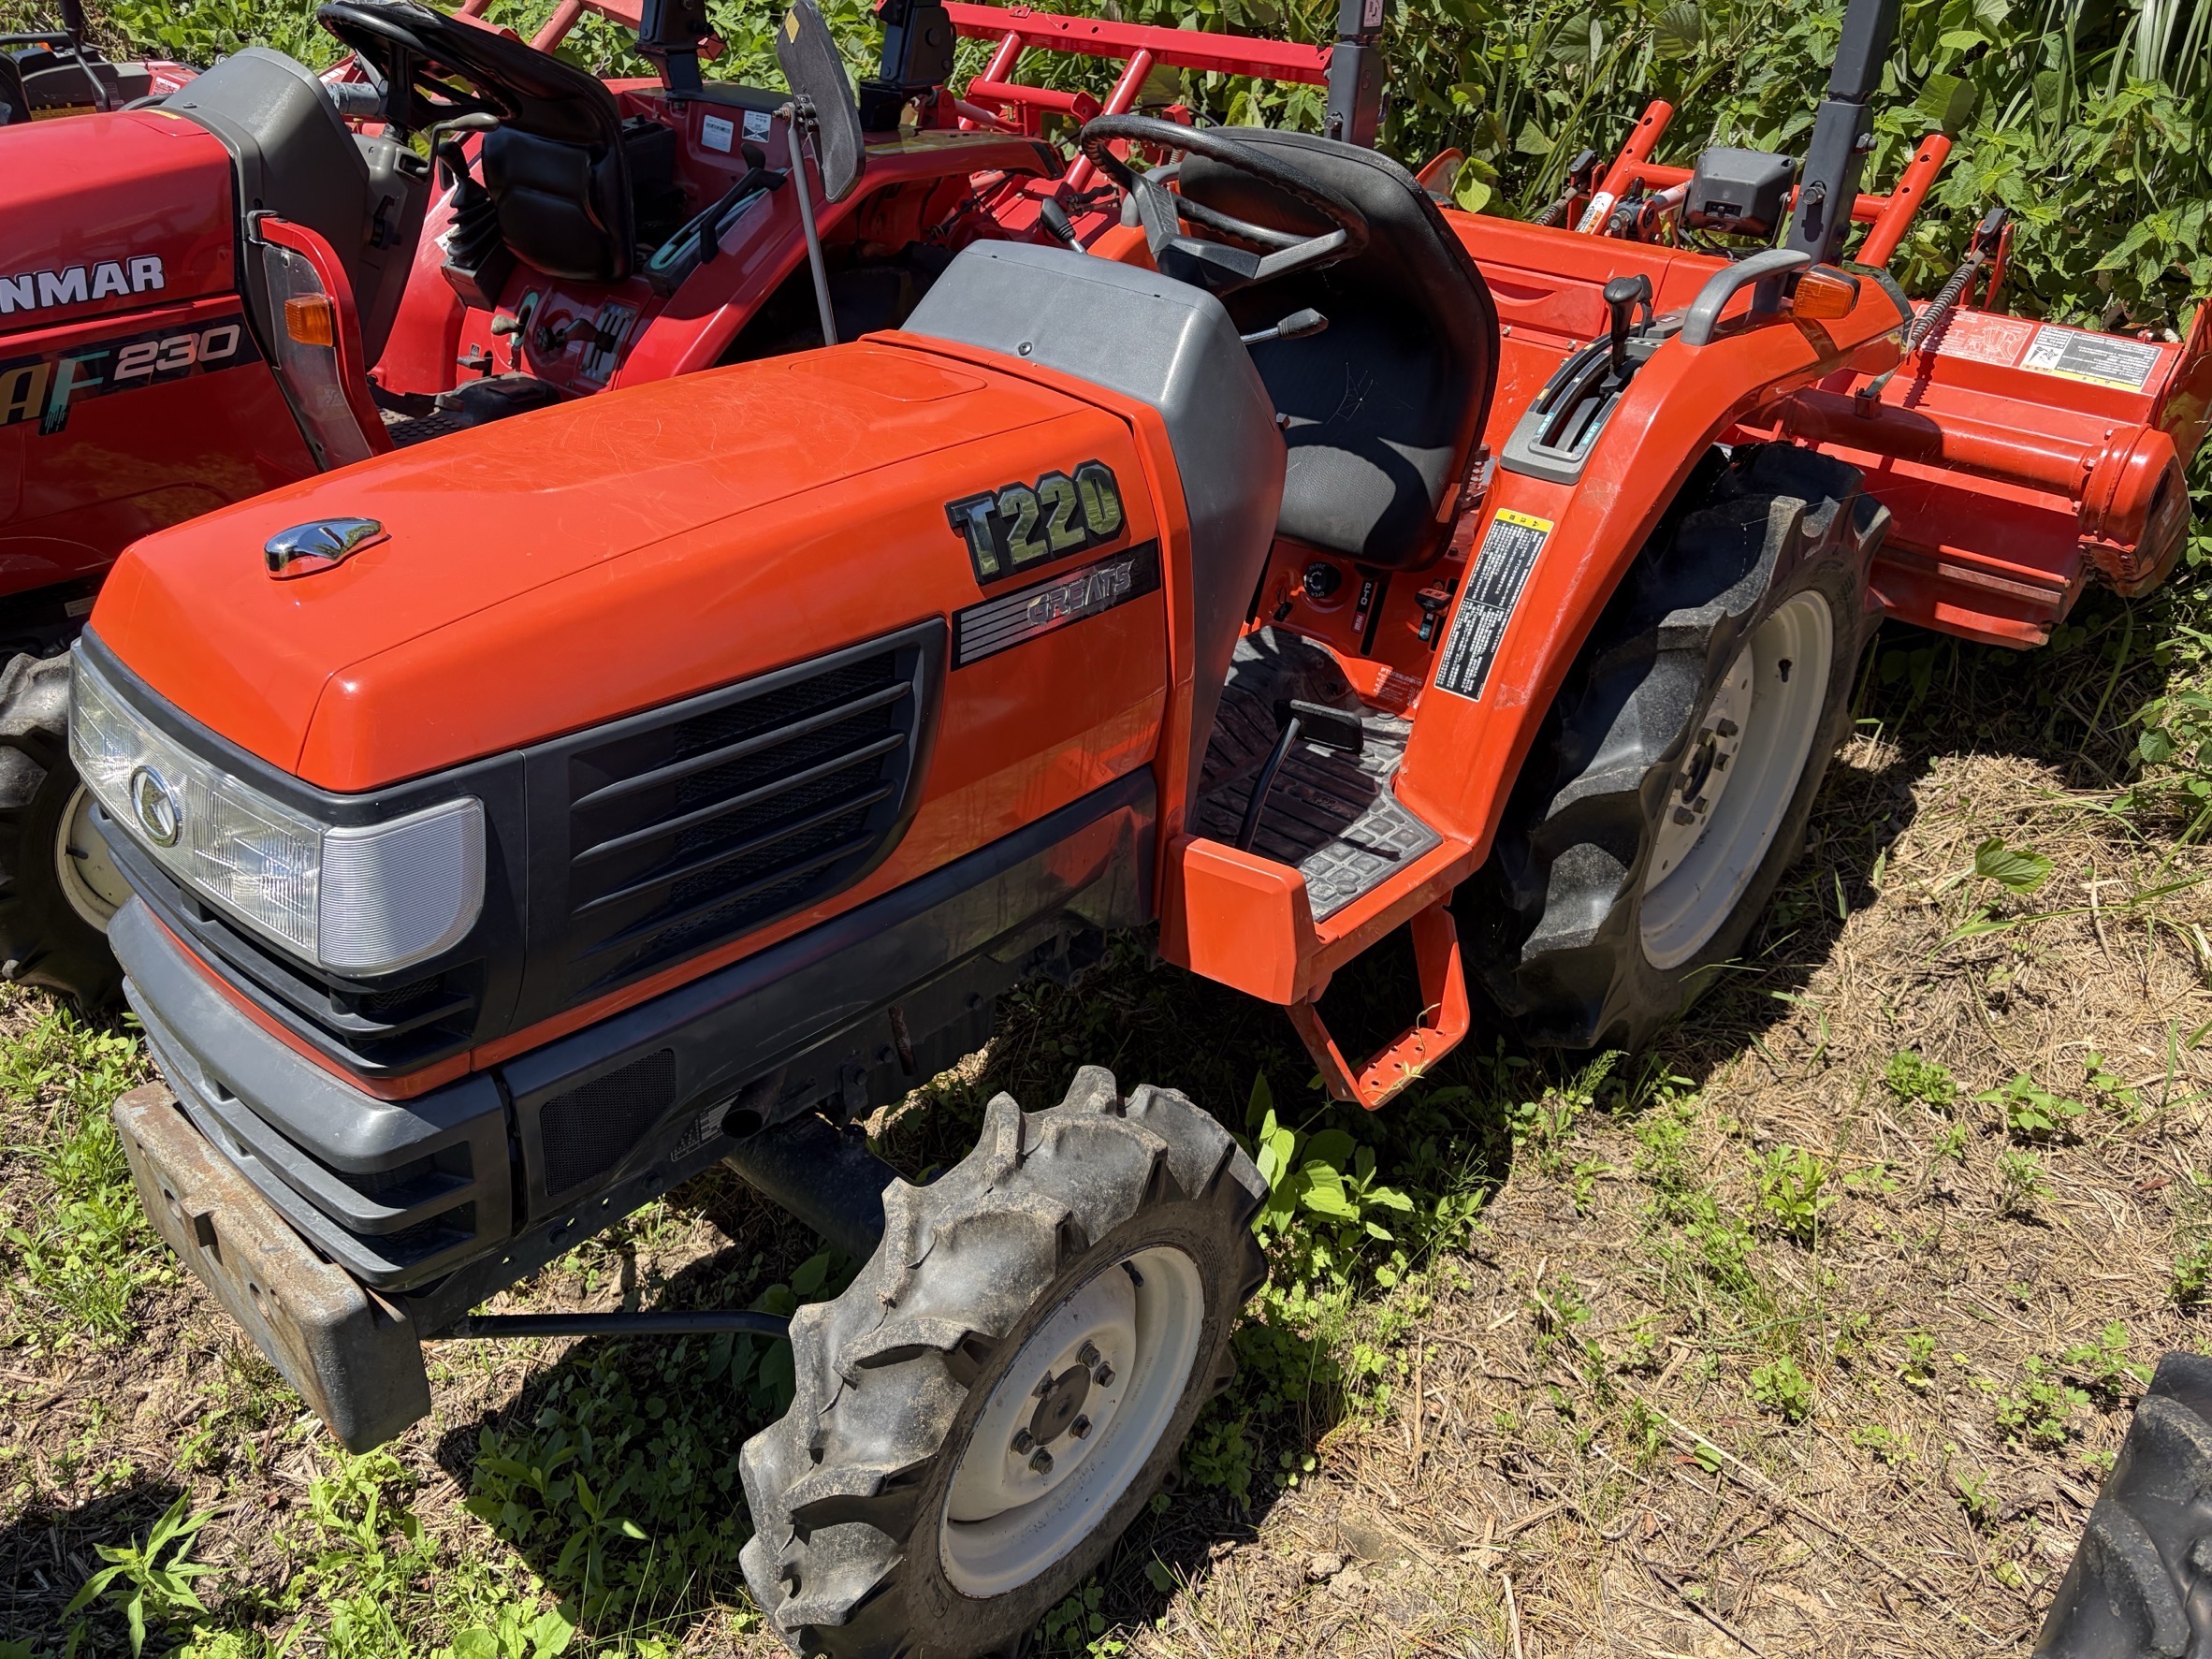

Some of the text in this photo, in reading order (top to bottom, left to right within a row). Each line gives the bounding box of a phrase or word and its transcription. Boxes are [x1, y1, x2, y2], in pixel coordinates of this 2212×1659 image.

[948, 461, 1126, 579] T220
[1027, 560, 1135, 626] GREATS
[1361, 582, 1372, 605] PTO
